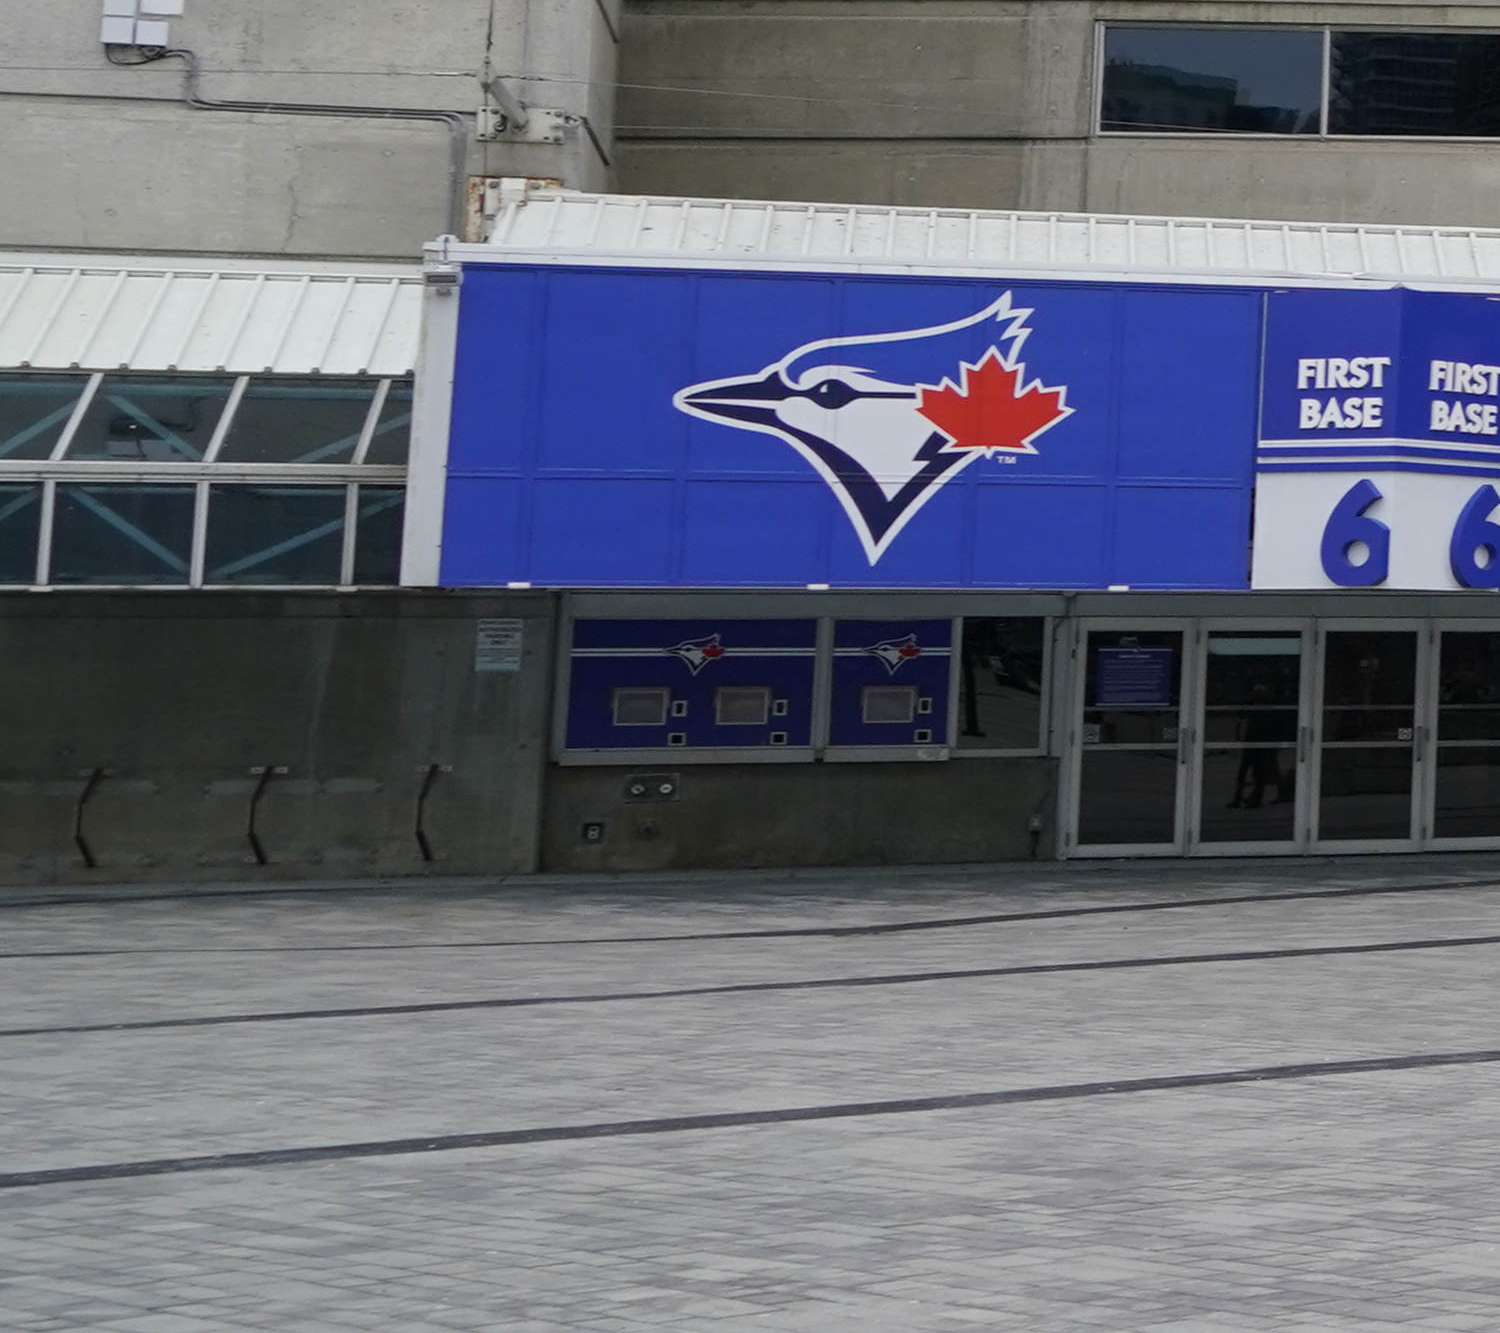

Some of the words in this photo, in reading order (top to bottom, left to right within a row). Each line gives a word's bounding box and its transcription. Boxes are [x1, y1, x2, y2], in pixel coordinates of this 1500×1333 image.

[1297, 356, 1391, 389] FIRST
[1299, 397, 1383, 429] BASE
[1429, 400, 1499, 435] BASE
[1320, 478, 1391, 587] 6
